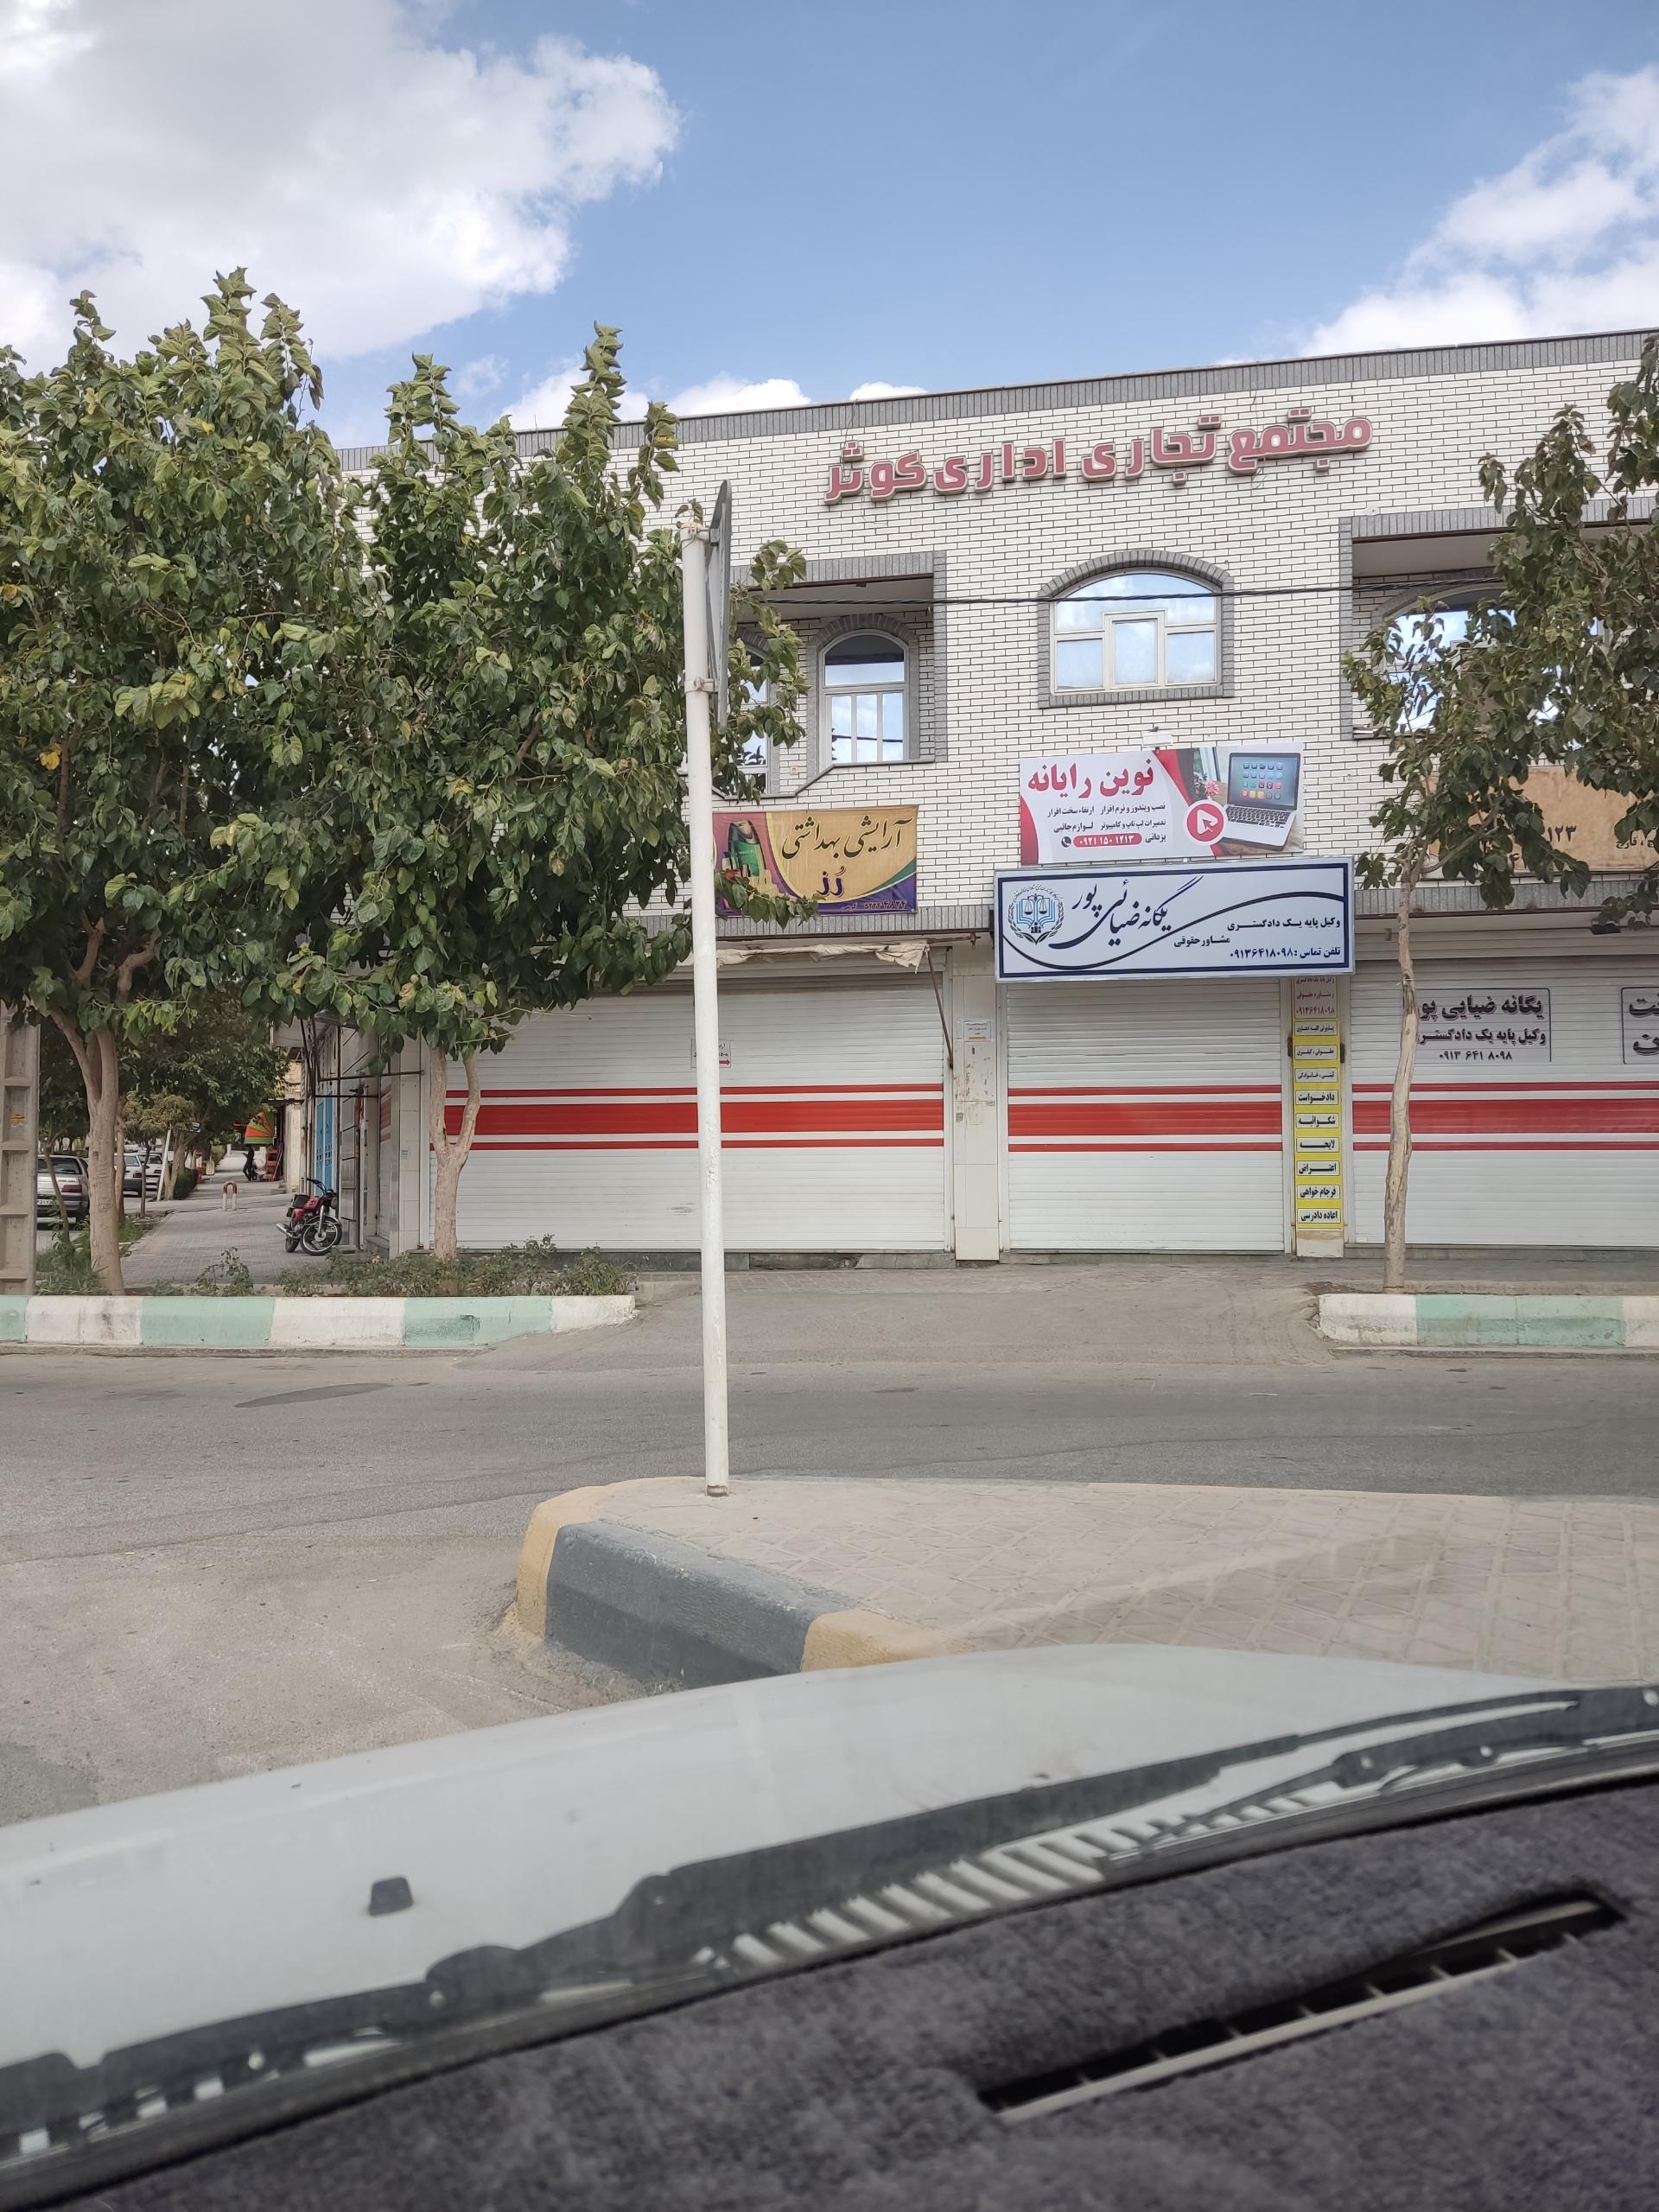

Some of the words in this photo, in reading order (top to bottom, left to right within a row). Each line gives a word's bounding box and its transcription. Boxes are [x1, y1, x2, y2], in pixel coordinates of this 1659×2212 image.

[1228, 407, 1374, 475] مجتمع
[1081, 414, 1221, 485] تجاری
[933, 437, 1067, 495] اداری
[824, 441, 928, 505] کوثر
[1027, 762, 1092, 798] رایانه
[1099, 759, 1154, 797] نوین
[1047, 807, 1061, 817] افزار
[1100, 804, 1115, 815] افزار
[1115, 804, 1125, 814] نرم
[1130, 804, 1150, 814] ویندوز
[1151, 803, 1166, 812] نصب
[1053, 823, 1072, 833] جانبی
[1072, 821, 1094, 832] لوازم
[1100, 821, 1122, 830] کامپیوتر
[1126, 820, 1135, 829] تاپ
[1136, 819, 1144, 829] لپ
[1145, 818, 1166, 829] تعمیرات
[781, 816, 842, 859] بهداشتی
[843, 815, 913, 858] آرایشی
[1145, 832, 1166, 843] یزدانی
[1071, 882, 1103, 918] پور
[1138, 874, 1205, 931] یگانه
[1227, 918, 1281, 931] دادگستری
[1282, 918, 1302, 929] یک
[1304, 918, 1319, 929] پایه
[1320, 917, 1340, 928] وکیل
[1173, 936, 1200, 947] حقوقی
[1201, 936, 1230, 946] مشاور
[1323, 946, 1341, 957] تلفن
[1418, 1000, 1438, 1022] پو
[1441, 995, 1497, 1021] ضیایی
[1501, 995, 1545, 1020] یگانه
[1417, 1028, 1472, 1045] دادگستر
[1475, 1028, 1495, 1045] یک
[1496, 1028, 1516, 1046] پایه
[1518, 1028, 1547, 1046] وکیل
[1440, 1051, 1462, 1060] ۰۹۱۳
[1465, 1050, 1484, 1061] ۶۴۱
[1487, 1050, 1513, 1061] ۸۰۹۸
[1298, 1091, 1335, 1104] دادخواست
[1299, 1139, 1335, 1150] لایحه
[1299, 1162, 1337, 1175] اعتراض
[1300, 1186, 1319, 1198] خواهی
[1319, 1185, 1337, 1198] فرجام
[1300, 1211, 1323, 1222] دادرسی
[1323, 1211, 1338, 1219] اعاده
